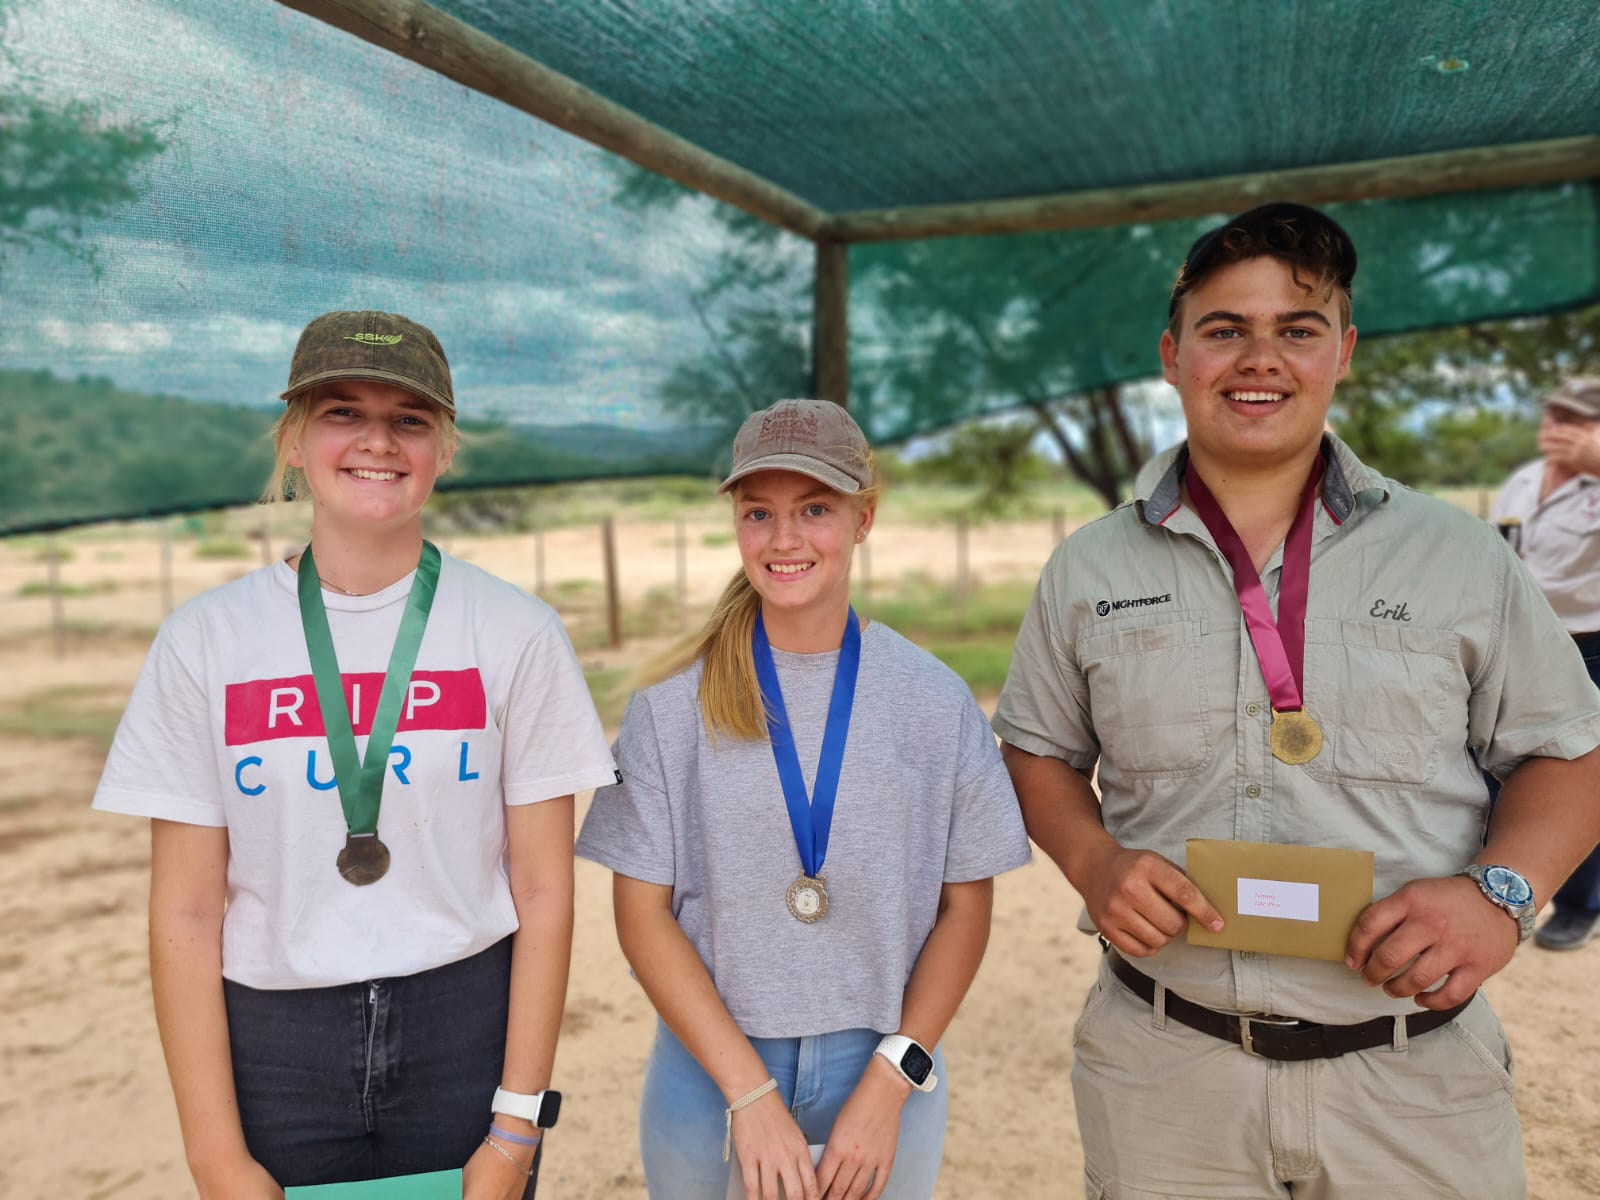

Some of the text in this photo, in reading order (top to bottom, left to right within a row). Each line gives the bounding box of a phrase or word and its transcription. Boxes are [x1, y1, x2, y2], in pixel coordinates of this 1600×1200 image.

[1111, 593, 1172, 611] NIGHTFORCE
[1369, 598, 1412, 622] Erik
[268, 680, 441, 729] RIP
[234, 741, 480, 797] CURL
